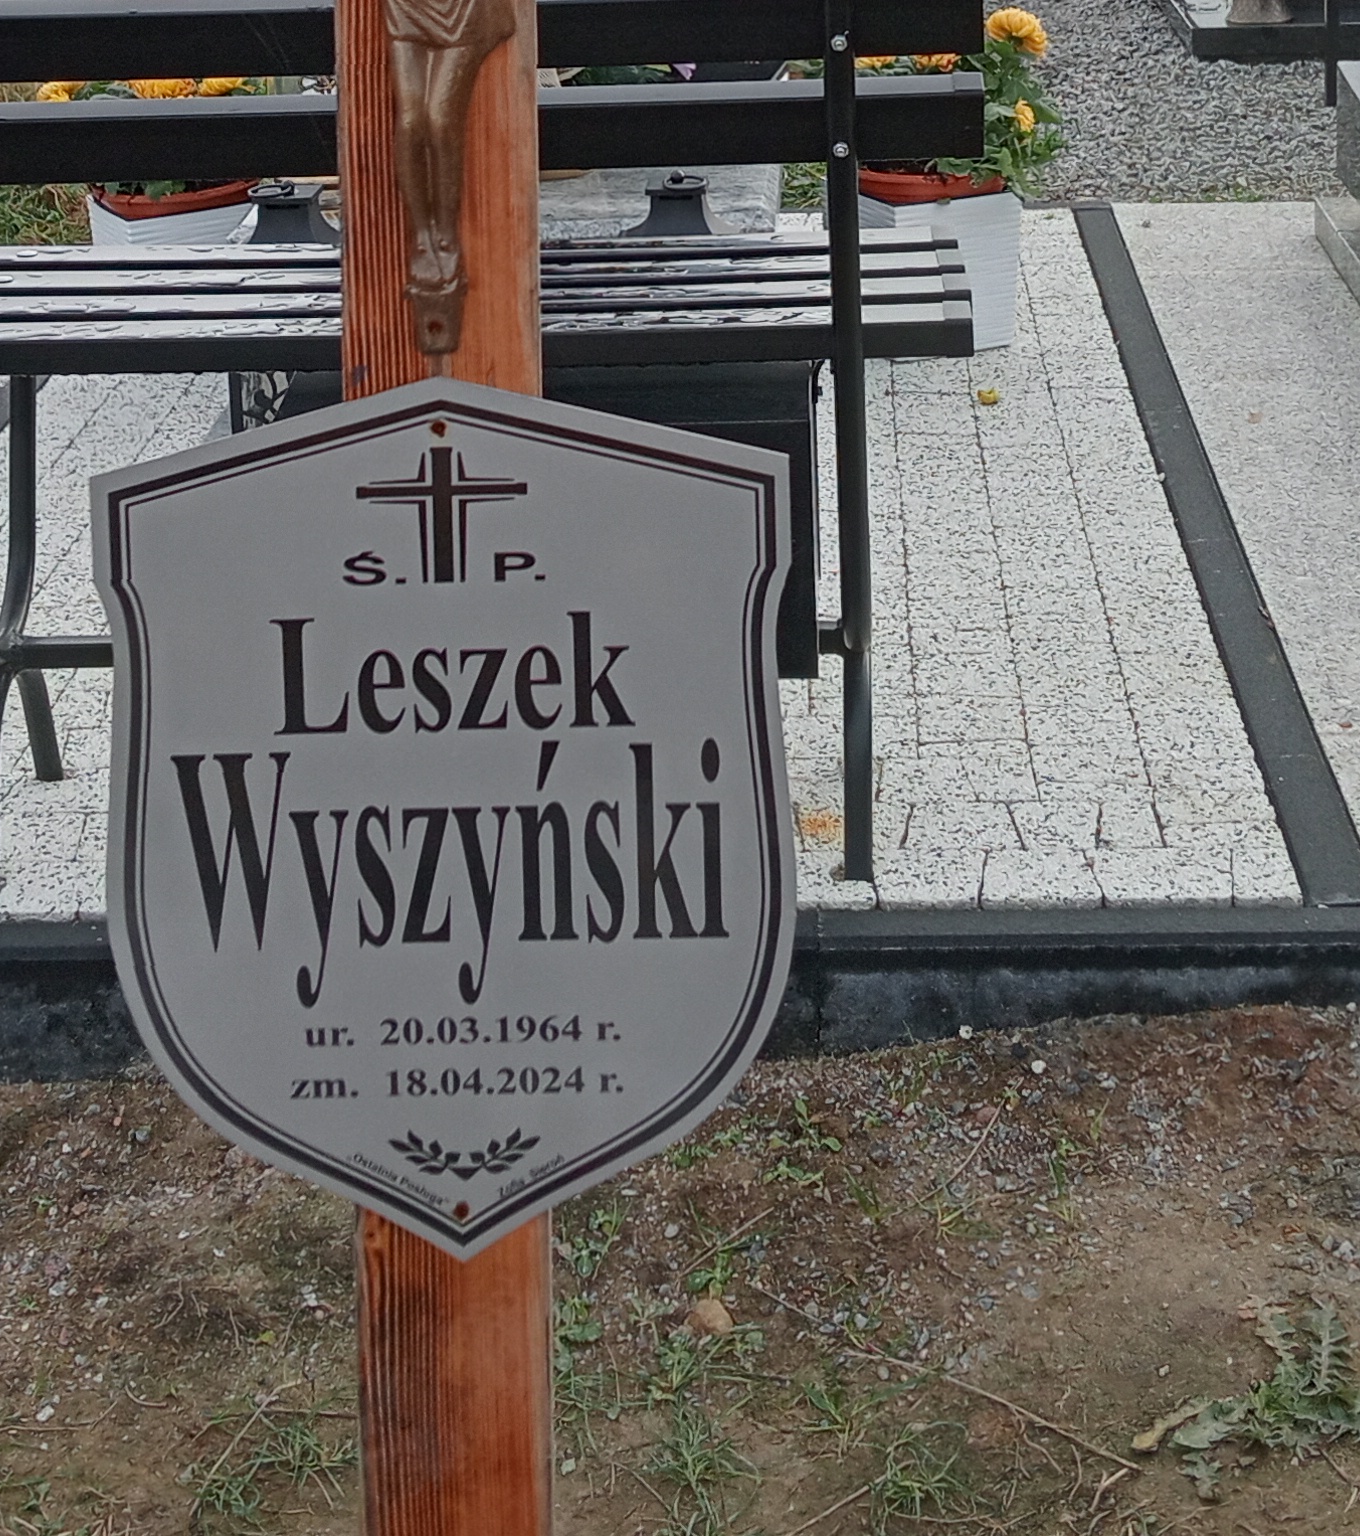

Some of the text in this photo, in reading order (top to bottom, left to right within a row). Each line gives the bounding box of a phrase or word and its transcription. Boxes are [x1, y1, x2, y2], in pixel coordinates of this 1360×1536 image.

[342, 550, 546, 586] Ś. P.
[269, 610, 636, 735] Leszek
[170, 737, 730, 1008] Wyszyński
[304, 1014, 622, 1048] ur. 20.03.1964 r.
[289, 1067, 625, 1100] zm. 18.04.2024 r.
